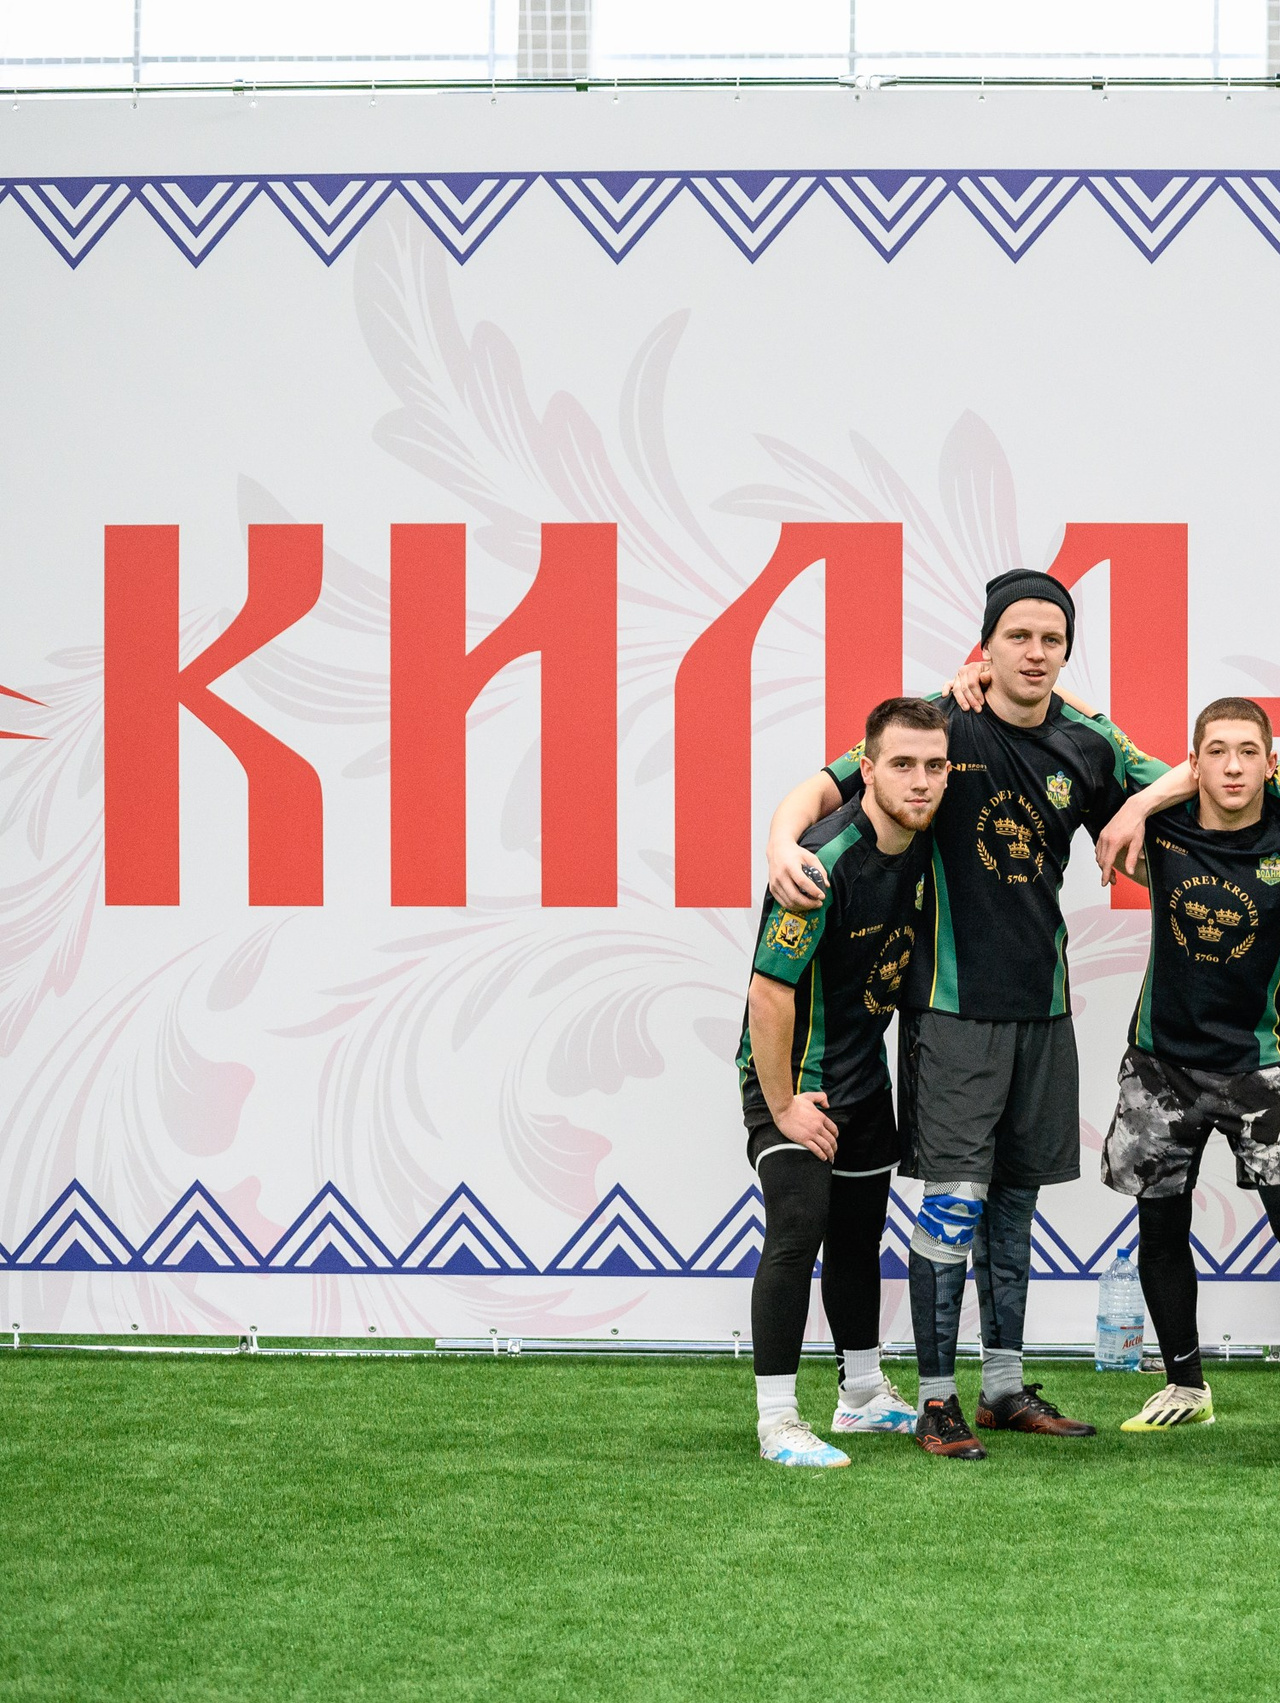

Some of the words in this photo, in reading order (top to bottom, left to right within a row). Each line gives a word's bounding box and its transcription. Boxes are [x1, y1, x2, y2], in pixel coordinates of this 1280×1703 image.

[976, 806, 991, 831] DIE
[989, 789, 1015, 807] DEY
[1171, 844, 1189, 855] SPORT
[1006, 874, 1028, 884] 5760
[1169, 887, 1183, 910] DIE
[1182, 875, 1219, 890] DREY
[1222, 880, 1259, 927] KRONEN
[1194, 952, 1220, 963] 5760
